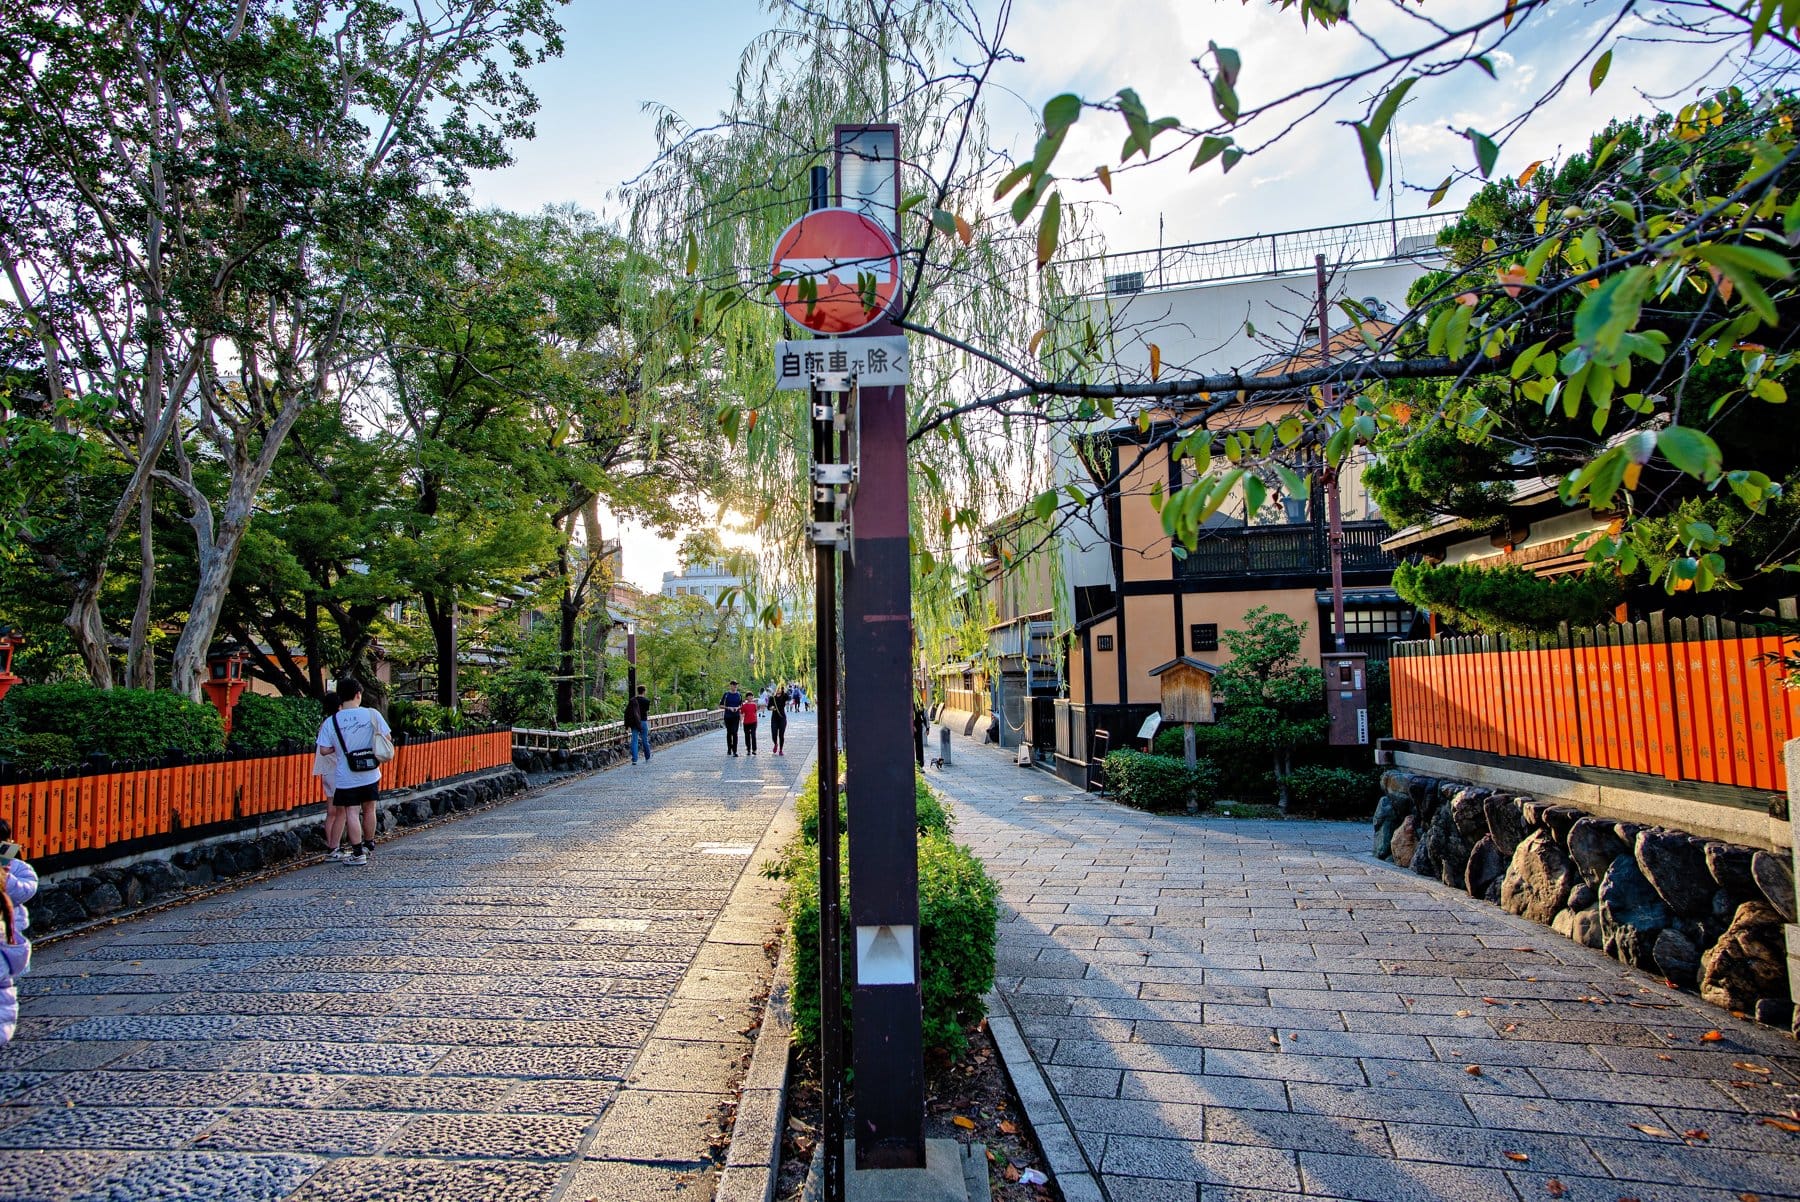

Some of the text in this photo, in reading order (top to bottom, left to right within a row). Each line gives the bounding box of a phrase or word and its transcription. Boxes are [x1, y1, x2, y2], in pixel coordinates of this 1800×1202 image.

[782, 348, 904, 377] 自転車を除く
